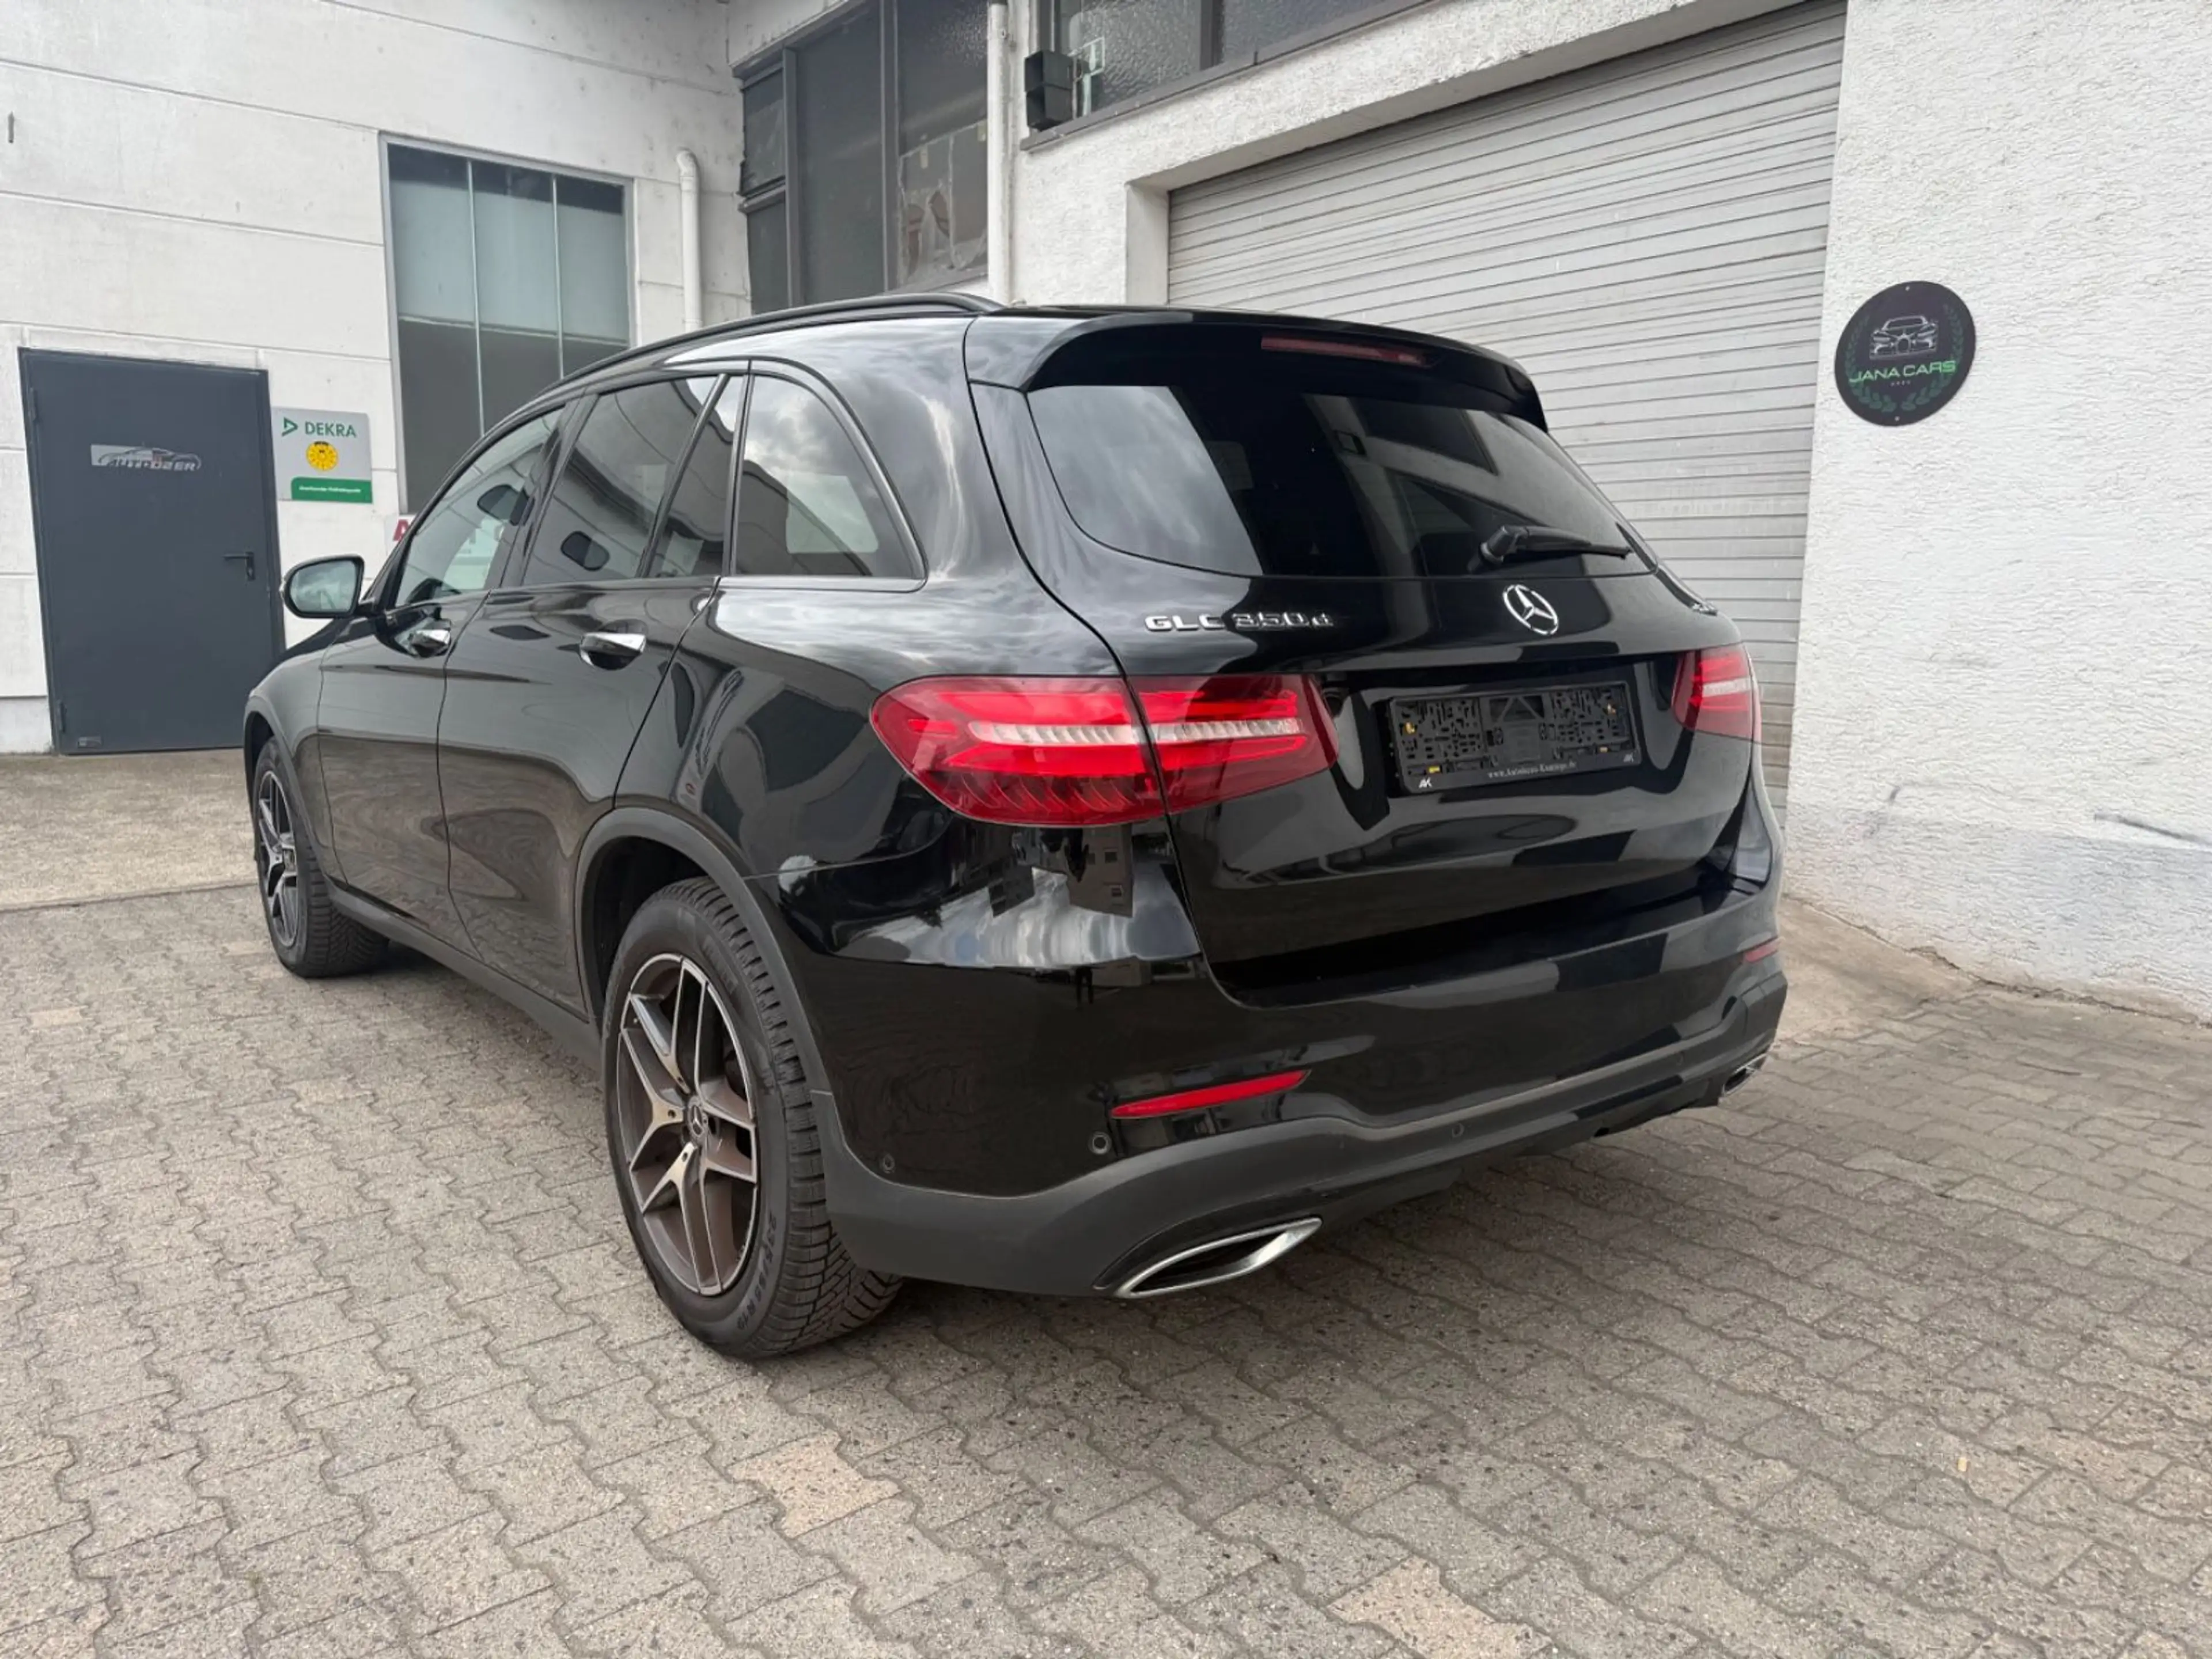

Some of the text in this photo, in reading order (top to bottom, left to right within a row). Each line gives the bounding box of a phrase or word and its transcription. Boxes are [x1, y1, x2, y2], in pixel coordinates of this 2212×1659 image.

[1849, 366, 1900, 383] JANA
[1903, 360, 1956, 378] CARS
[305, 421, 357, 438] DEKRA
[1145, 615, 1226, 631] GLC
[1418, 777, 1433, 789] AK
